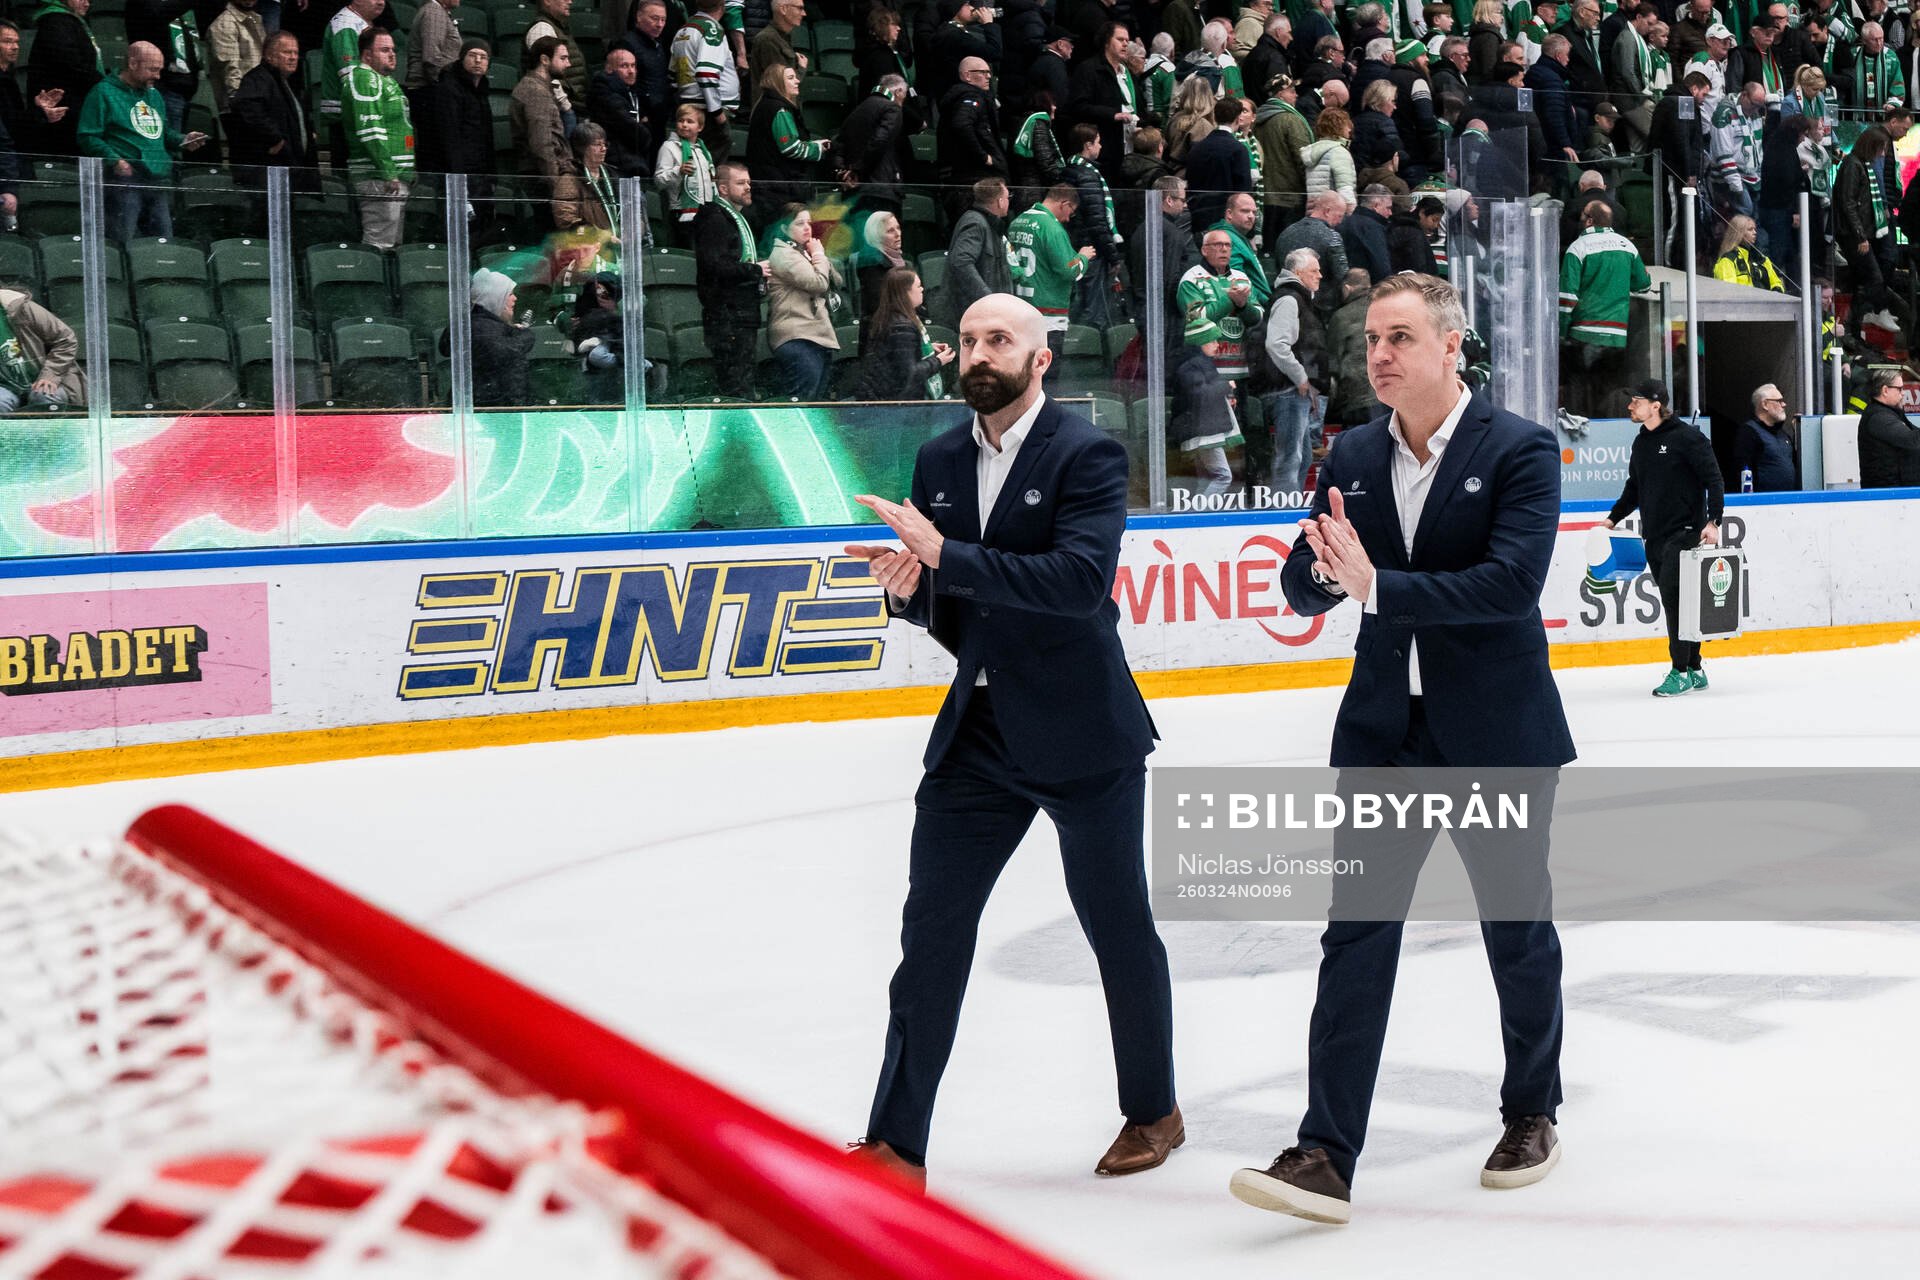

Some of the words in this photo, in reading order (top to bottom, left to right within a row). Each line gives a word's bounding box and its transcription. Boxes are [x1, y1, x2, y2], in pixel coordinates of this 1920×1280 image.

[1171, 487, 1247, 513] Boozt
[1253, 485, 1316, 510] Booz
[1587, 469, 1630, 481] PROST
[1111, 539, 1296, 625] WINE
[0, 624, 207, 695] BLADET
[490, 557, 827, 694] HNT
